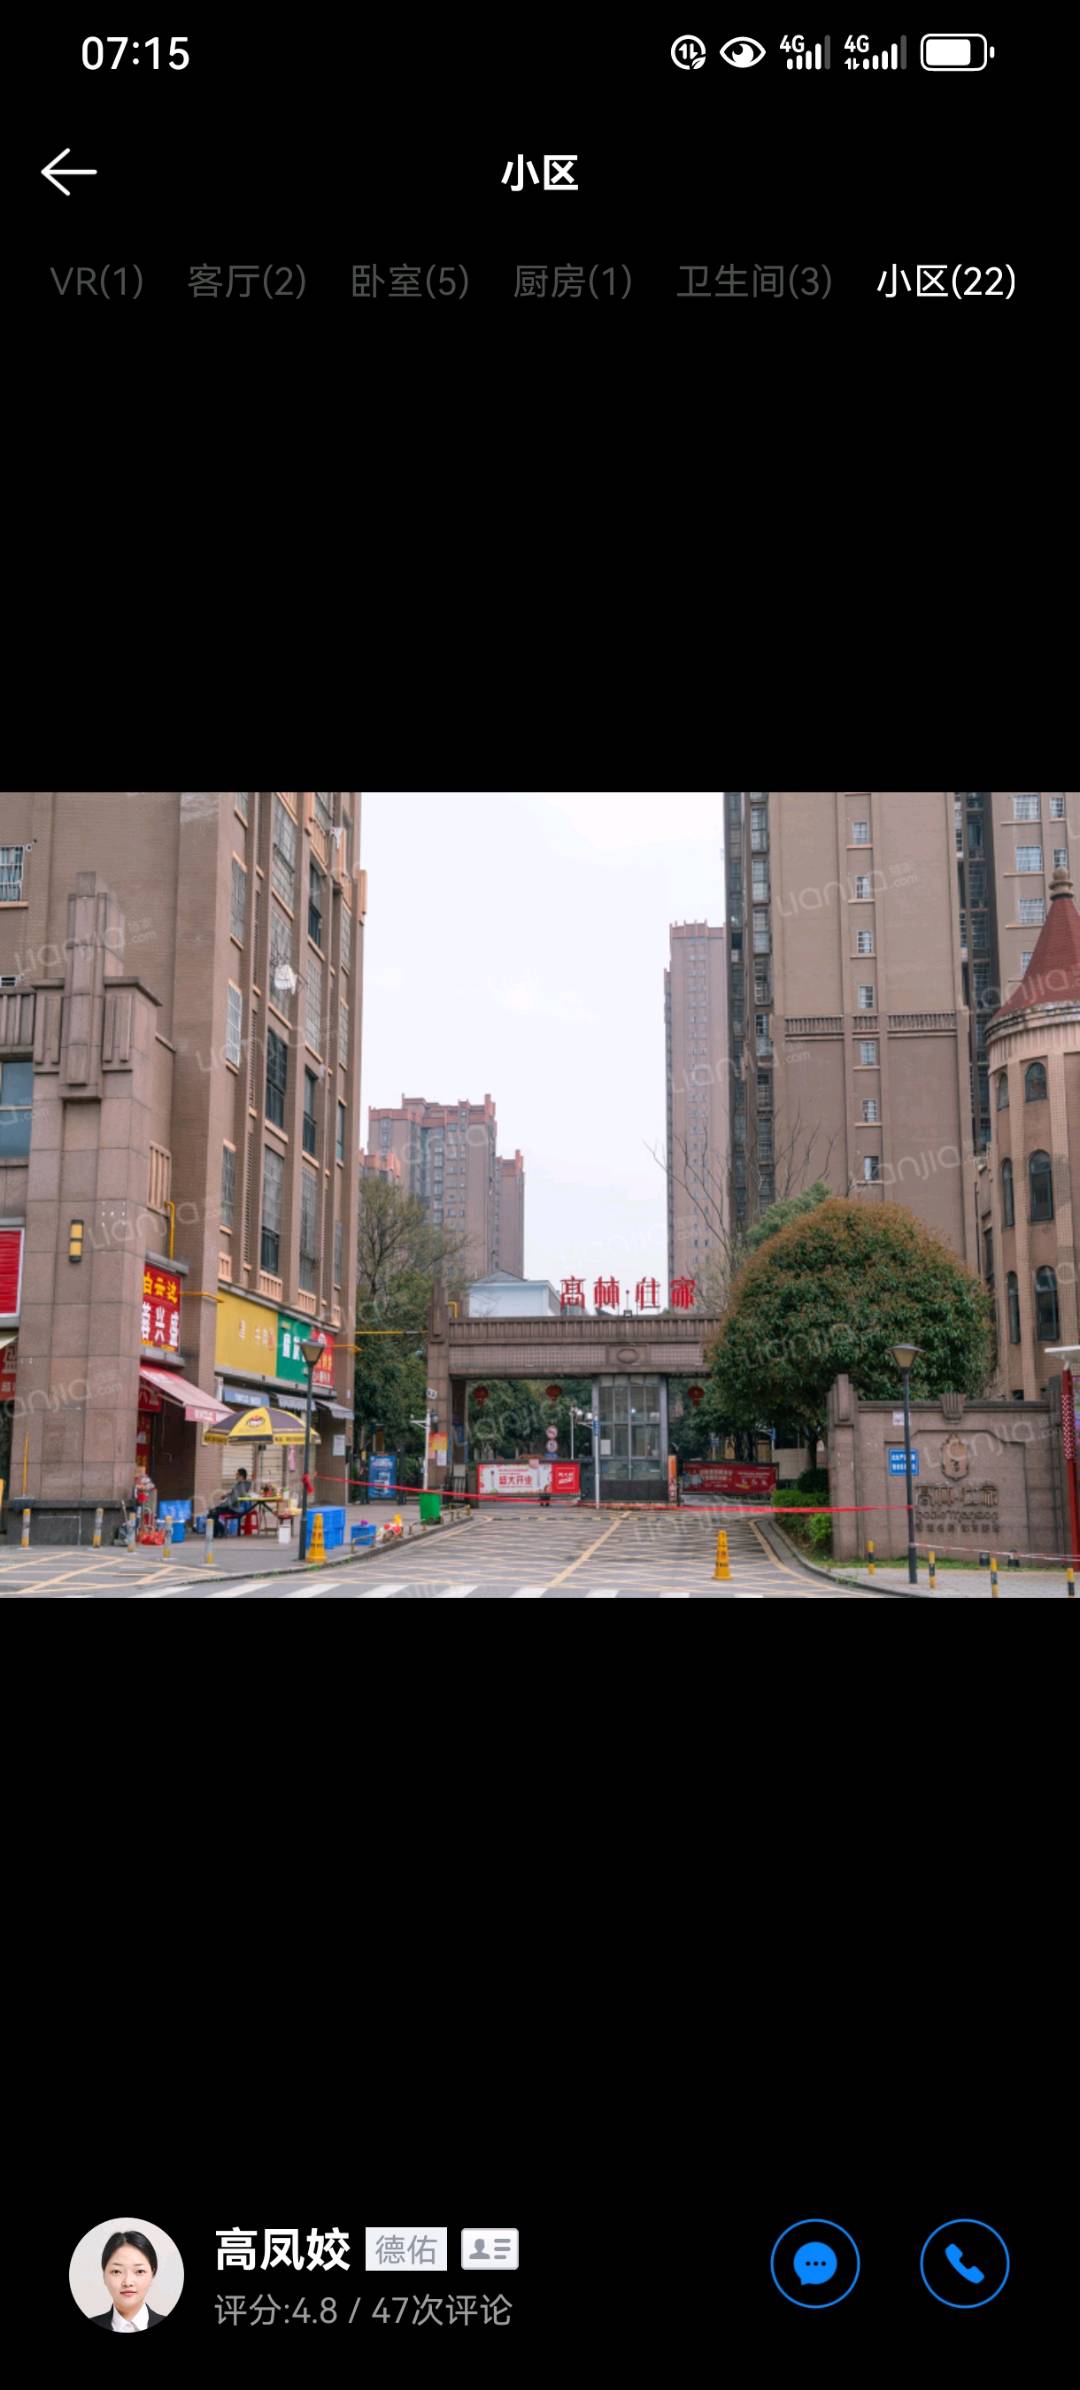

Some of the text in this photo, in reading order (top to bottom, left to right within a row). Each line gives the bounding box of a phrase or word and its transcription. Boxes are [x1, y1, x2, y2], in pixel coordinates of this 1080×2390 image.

[82, 36, 189, 71] 07:15
[780, 35, 870, 53] 4G 4G
[501, 154, 579, 192] 小区
[50, 263, 1016, 300] VR(1) 客厅(2) 卧室(5) 厨房(1) 卫生间(3) 小区(22)
[216, 2226, 438, 2272] 高凤姣 德佑
[214, 2294, 513, 2327] 评分:4.8 / 47次评论
